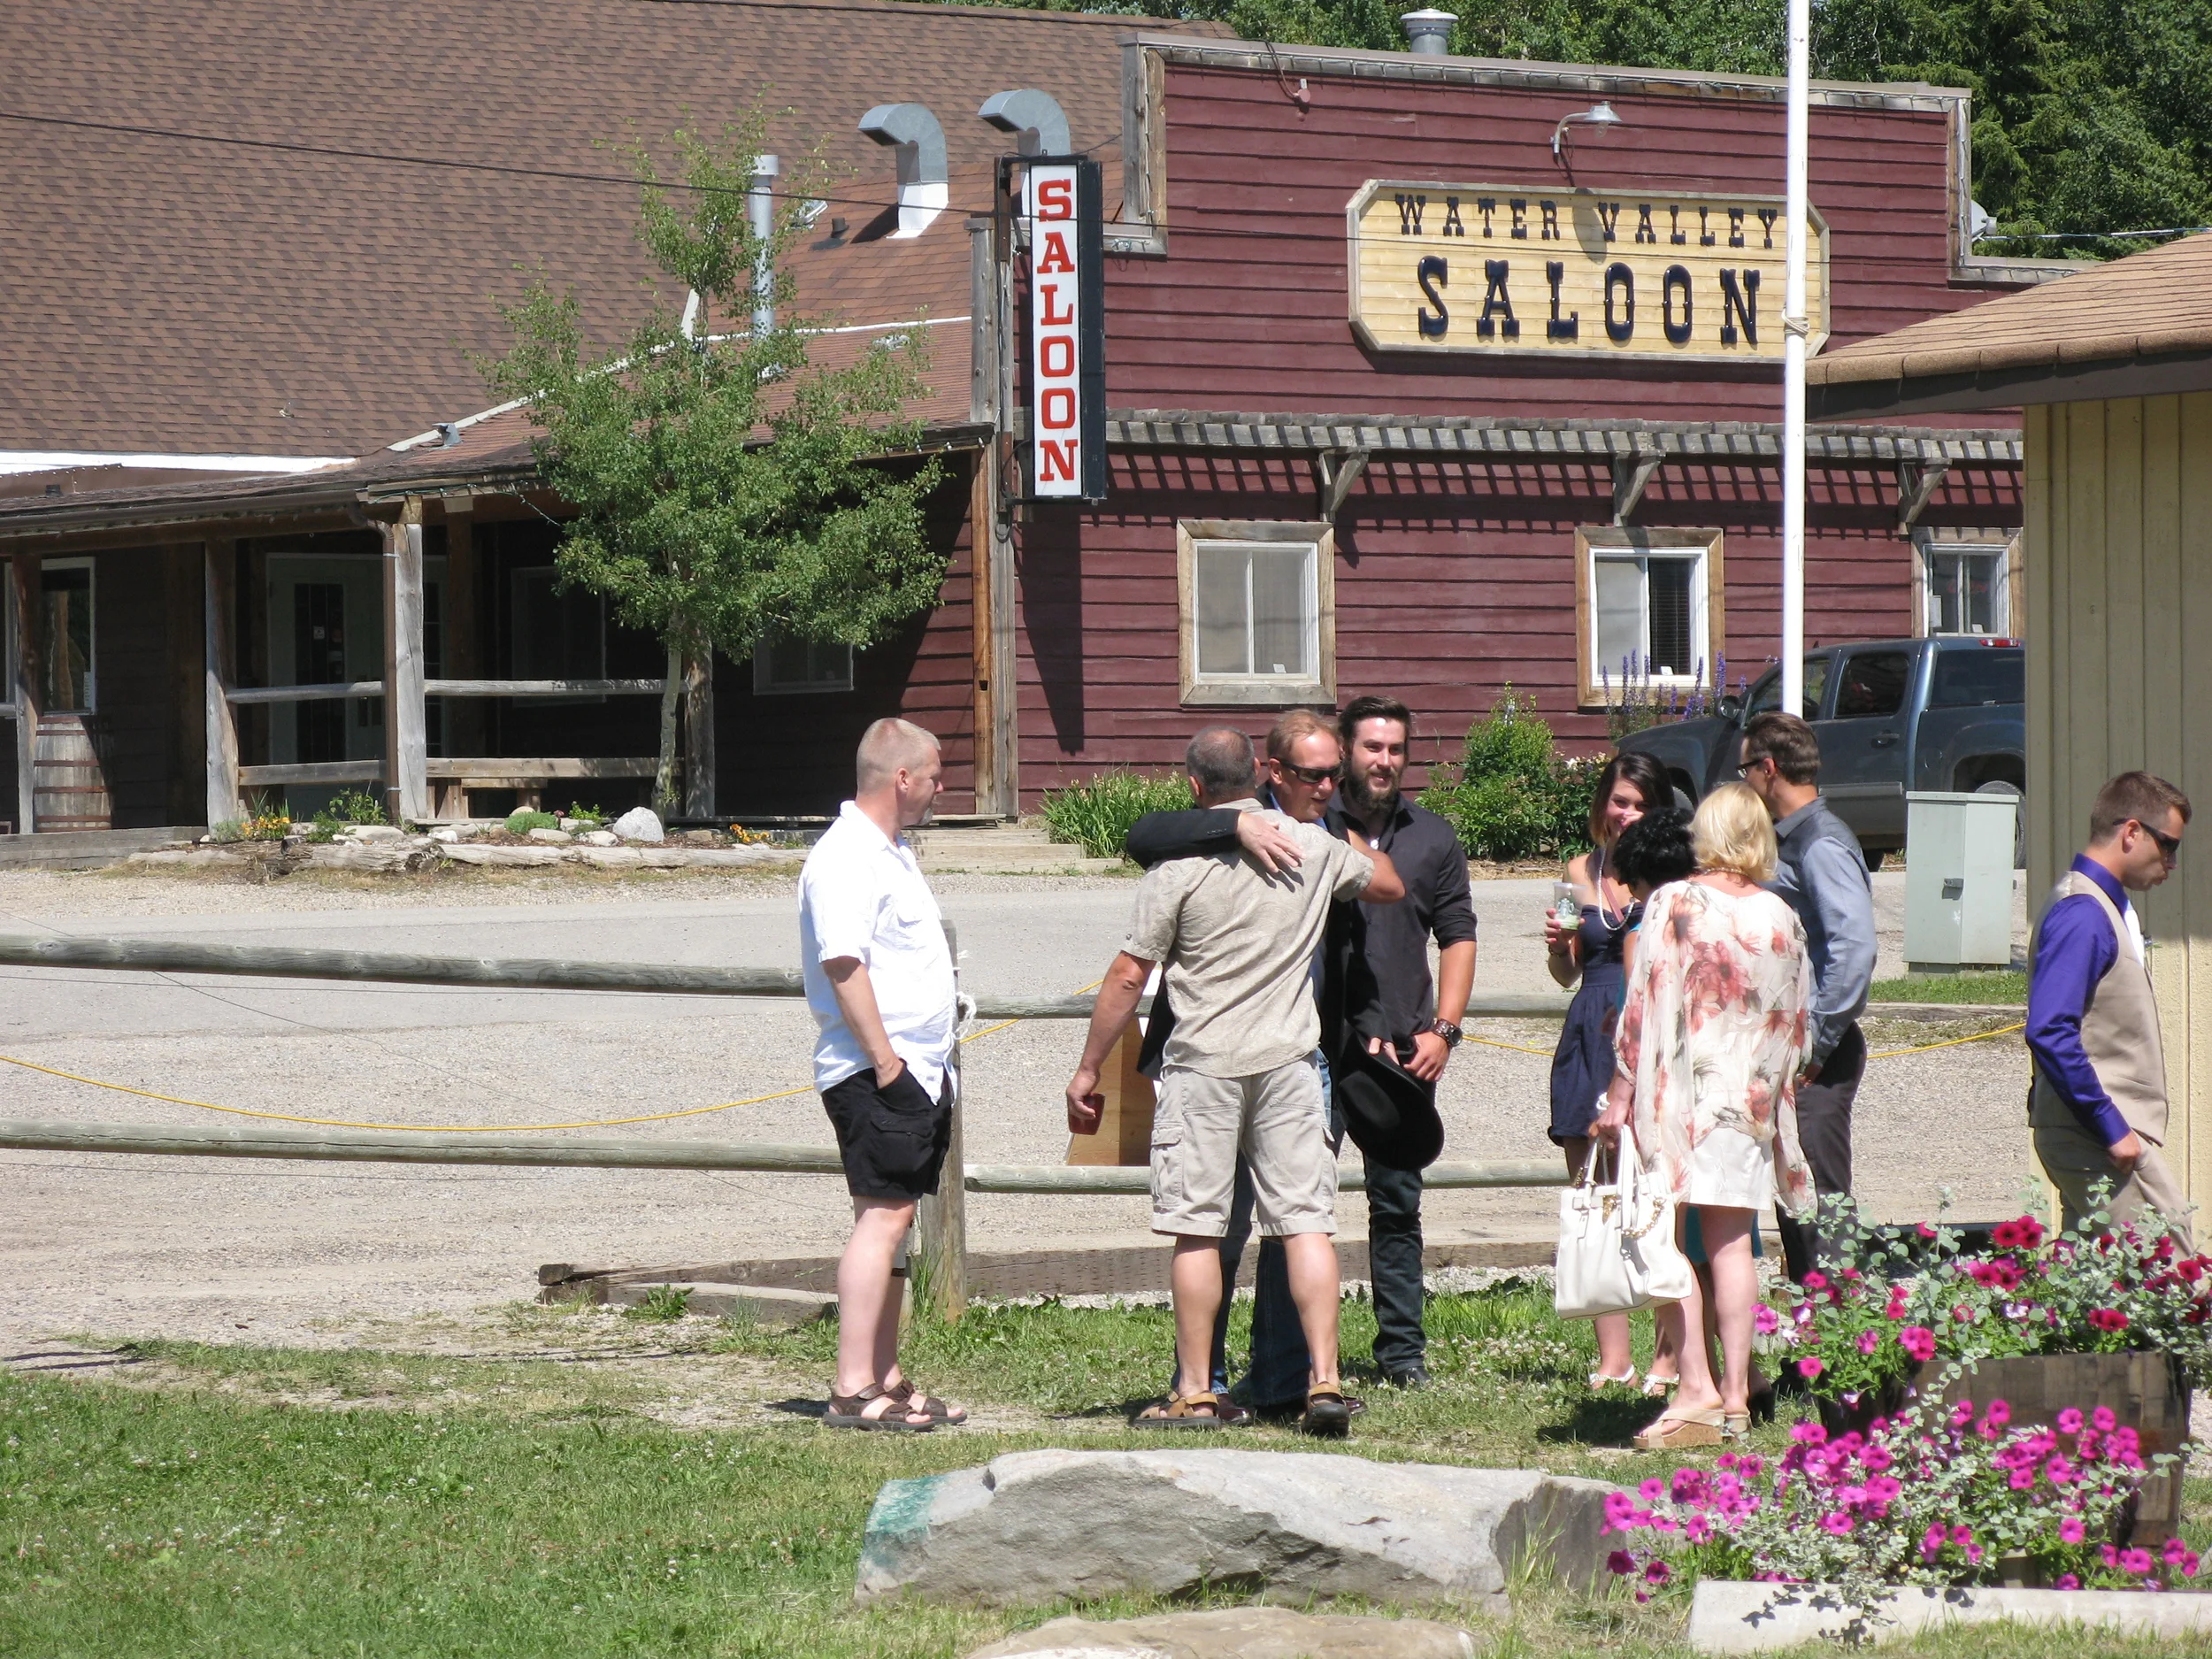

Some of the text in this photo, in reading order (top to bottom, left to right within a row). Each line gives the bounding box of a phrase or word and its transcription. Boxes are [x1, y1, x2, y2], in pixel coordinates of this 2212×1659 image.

[1394, 194, 1778, 249] WATER VALLEY
[1038, 179, 1078, 481] SALOON
[1417, 255, 1760, 349] SALOON
